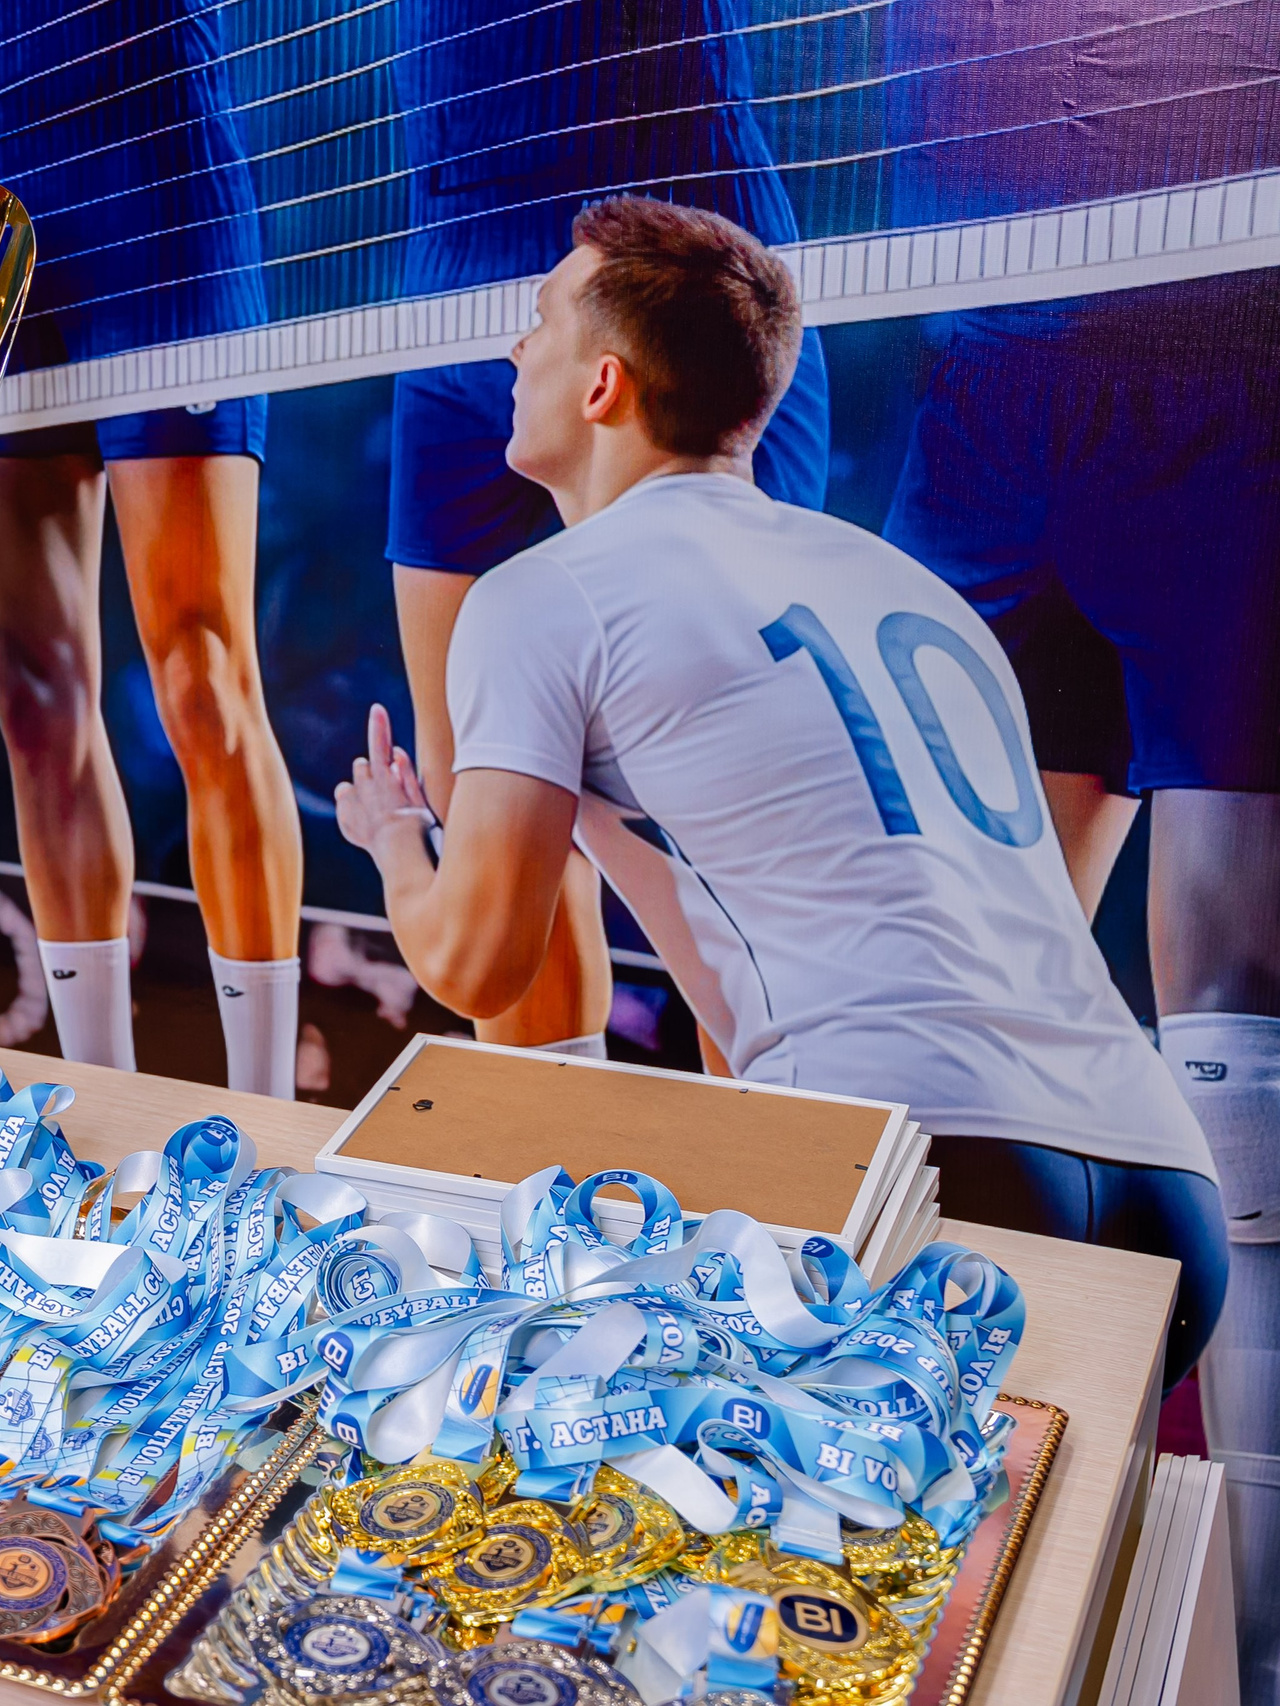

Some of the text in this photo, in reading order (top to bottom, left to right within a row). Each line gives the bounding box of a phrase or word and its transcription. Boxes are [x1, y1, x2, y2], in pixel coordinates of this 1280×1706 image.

[758, 602, 1044, 849] 10
[58, 1150, 76, 1175] BI
[200, 1179, 228, 1198] BI
[150, 1155, 183, 1253] АСТАНА
[649, 1214, 672, 1240] BI
[221, 1283, 248, 1337] 2026
[323, 1337, 348, 1372] BI
[847, 1331, 916, 1355] 2026
[981, 1327, 1012, 1356] BI
[31, 1343, 62, 1371] BI
[275, 1345, 309, 1376] BI
[11, 1391, 30, 1424] VOLLEYBALL
[732, 1404, 763, 1433] BI
[131, 1381, 216, 1470] VOLLEYBALL
[195, 1425, 220, 1452] BI
[516, 1426, 543, 1452] Г.
[550, 1405, 668, 1449] АСТАНА
[866, 1421, 905, 1442] BI
[816, 1443, 856, 1476] BI
[117, 1467, 148, 1486] BI
[793, 1601, 843, 1636] BI
